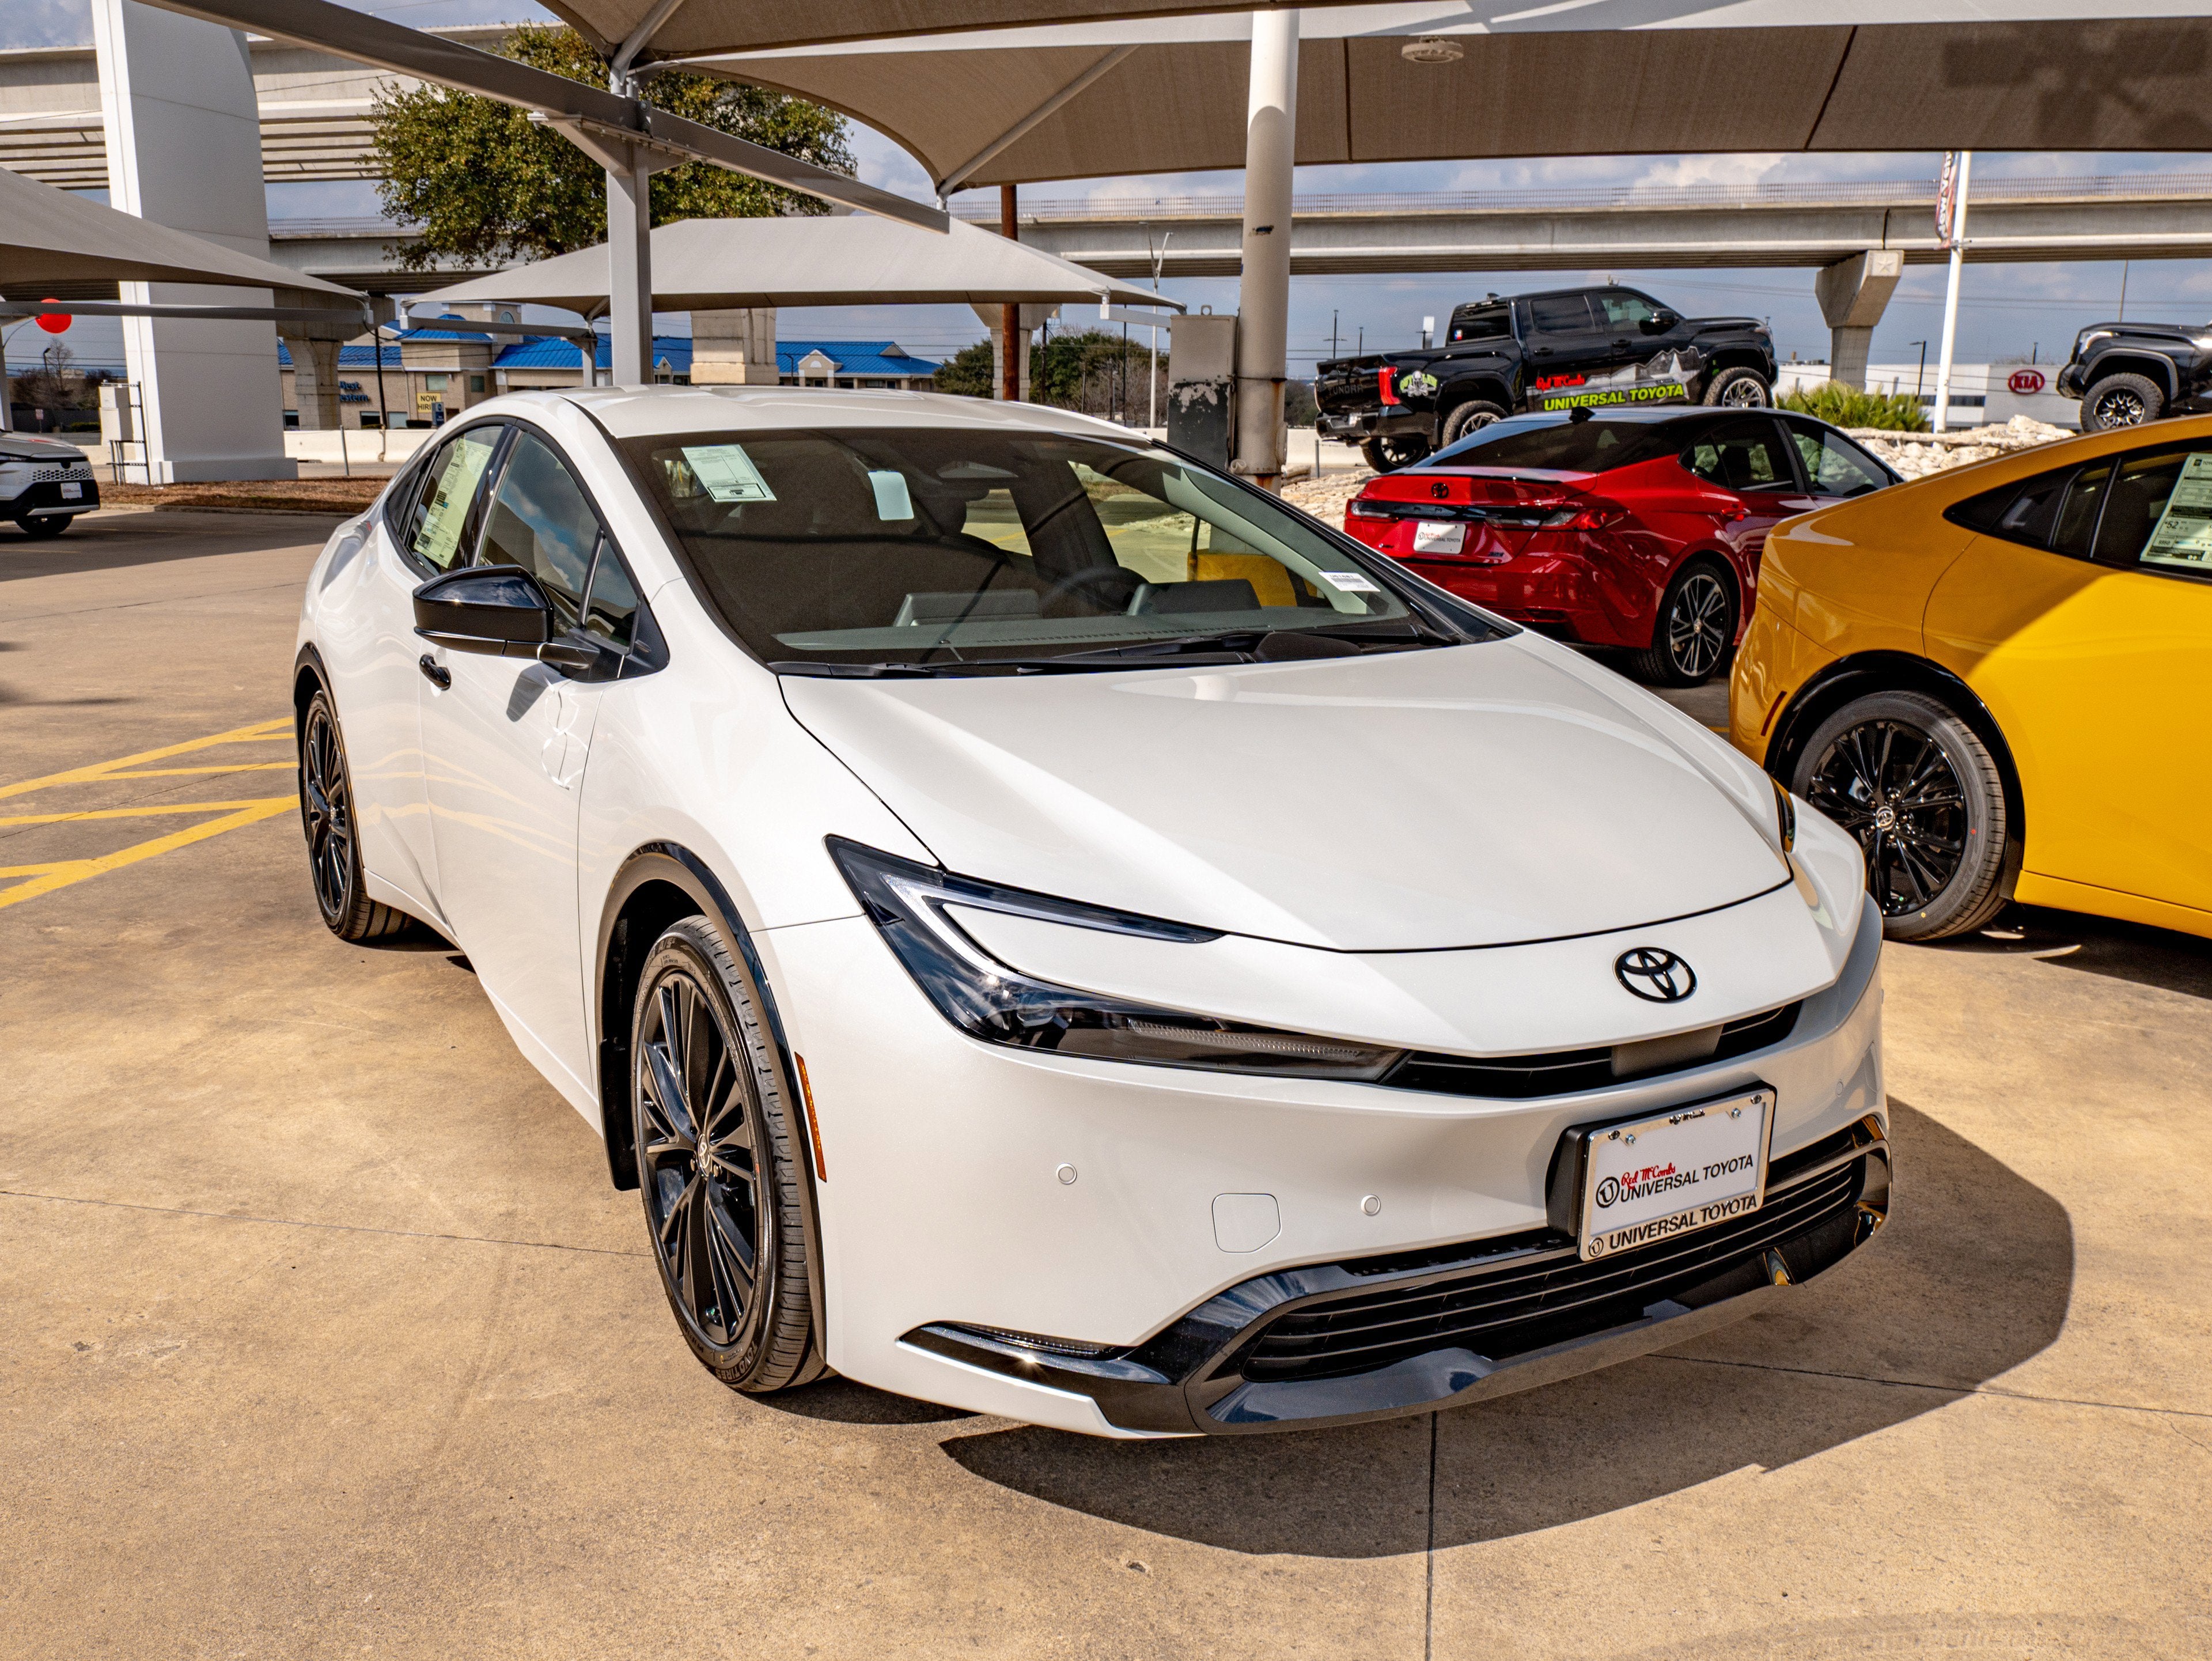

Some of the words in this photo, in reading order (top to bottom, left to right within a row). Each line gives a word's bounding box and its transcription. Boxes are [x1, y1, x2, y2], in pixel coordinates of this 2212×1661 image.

[339, 381, 359, 390] Best
[339, 394, 369, 402] estern
[1544, 391, 1626, 411] UNIVERSAL
[1629, 384, 1684, 402] TOYOTA
[1620, 1170, 1699, 1202] UNIVERSAL
[1703, 1154, 1753, 1180] TOYOTA
[1621, 1170, 1639, 1190] Red
[1640, 1162, 1676, 1181] McCombs
[1609, 1212, 1698, 1250] UNIVERSAL
[1700, 1194, 1758, 1223] TOYOTA
